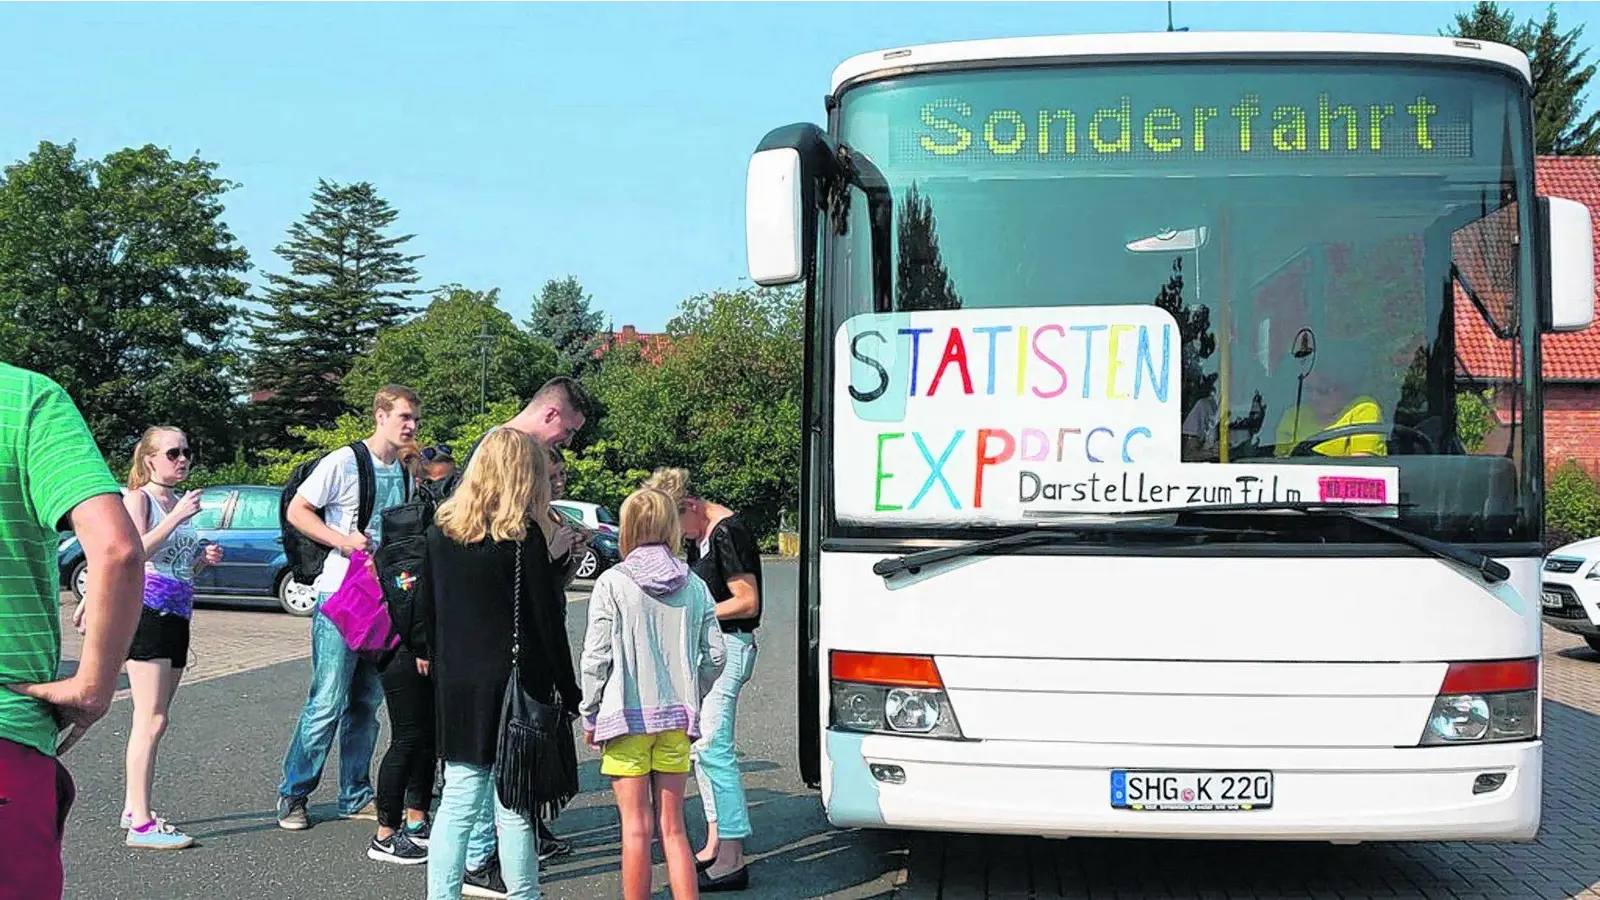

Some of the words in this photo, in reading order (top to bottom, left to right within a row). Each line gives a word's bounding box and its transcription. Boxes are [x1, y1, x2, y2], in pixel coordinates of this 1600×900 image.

[919, 92, 1438, 155] Sonderfahrt
[848, 324, 1171, 403] STATISTEN
[1019, 470, 1180, 503] Darsteller
[1235, 475, 1301, 504] Film
[1128, 777, 1178, 800] SHG
[1197, 777, 1212, 800] K
[1221, 777, 1268, 800] 220
